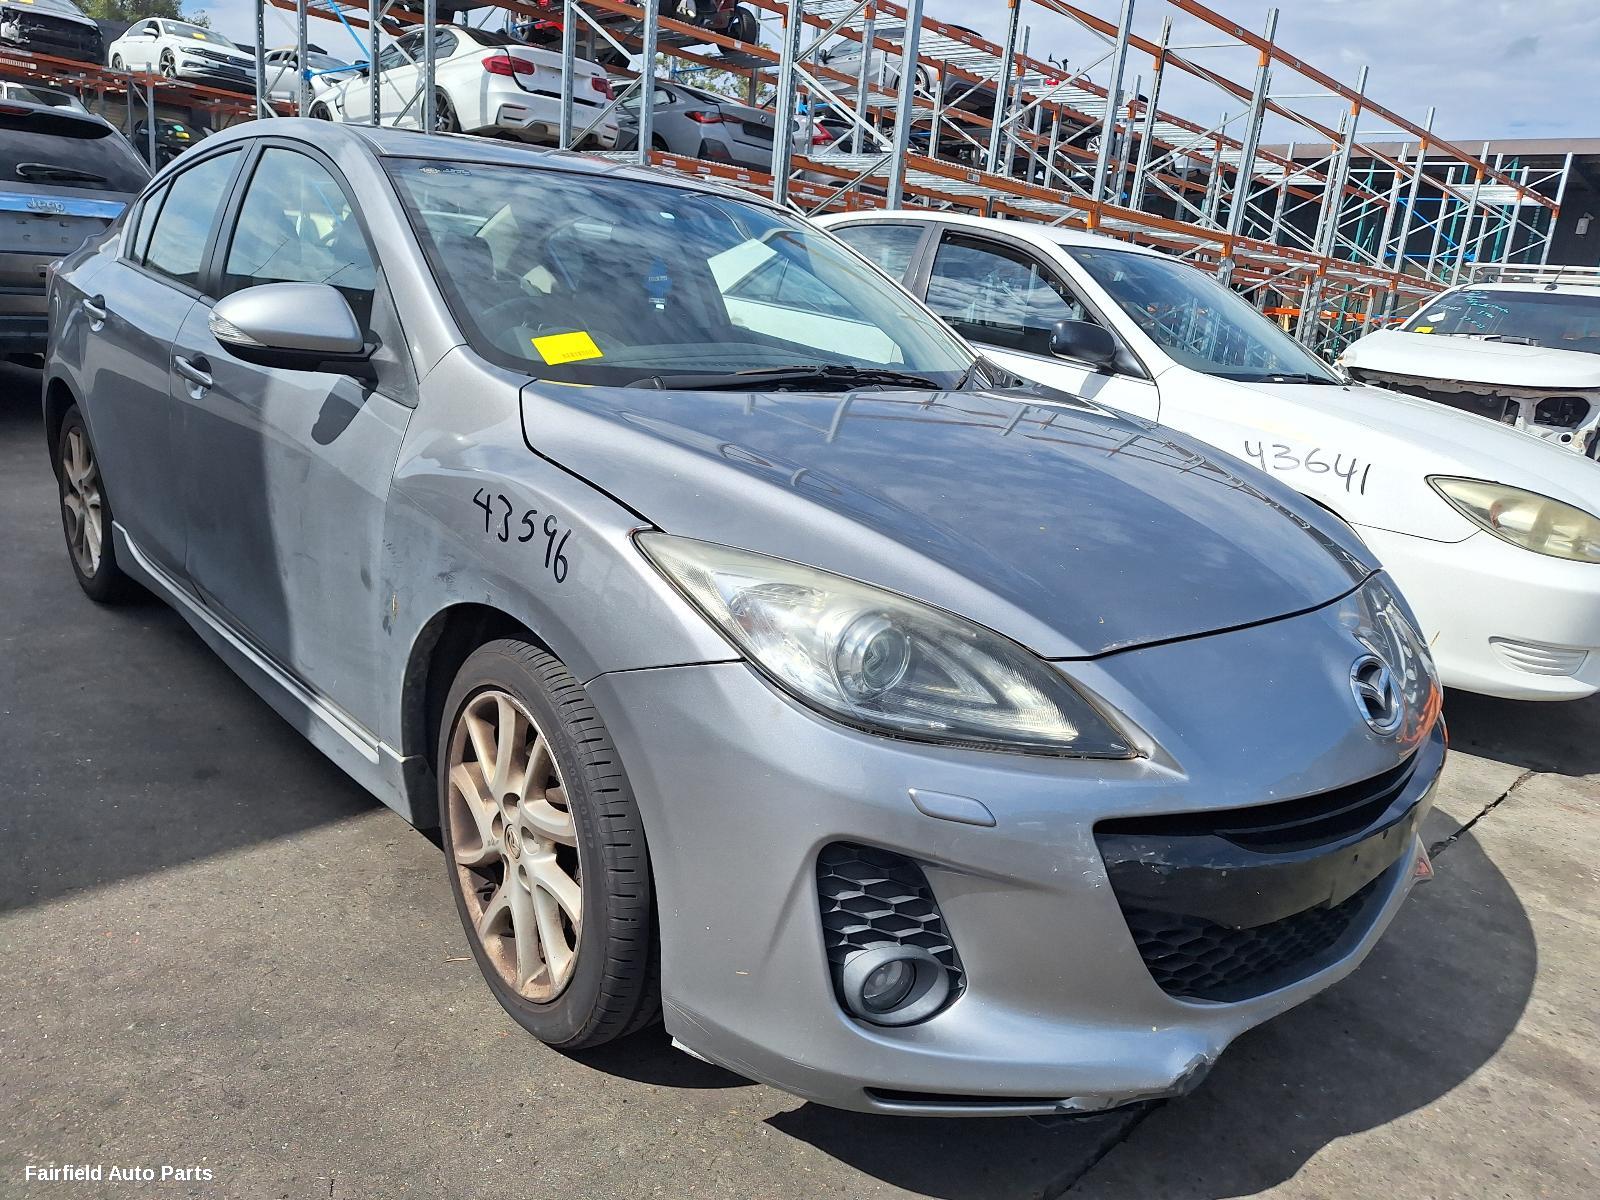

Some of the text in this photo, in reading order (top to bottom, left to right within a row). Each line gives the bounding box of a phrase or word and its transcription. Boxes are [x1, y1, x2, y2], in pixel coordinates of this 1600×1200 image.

[26, 198, 65, 213] Jeep
[1244, 440, 1371, 495] 43641
[472, 487, 572, 583] 43596
